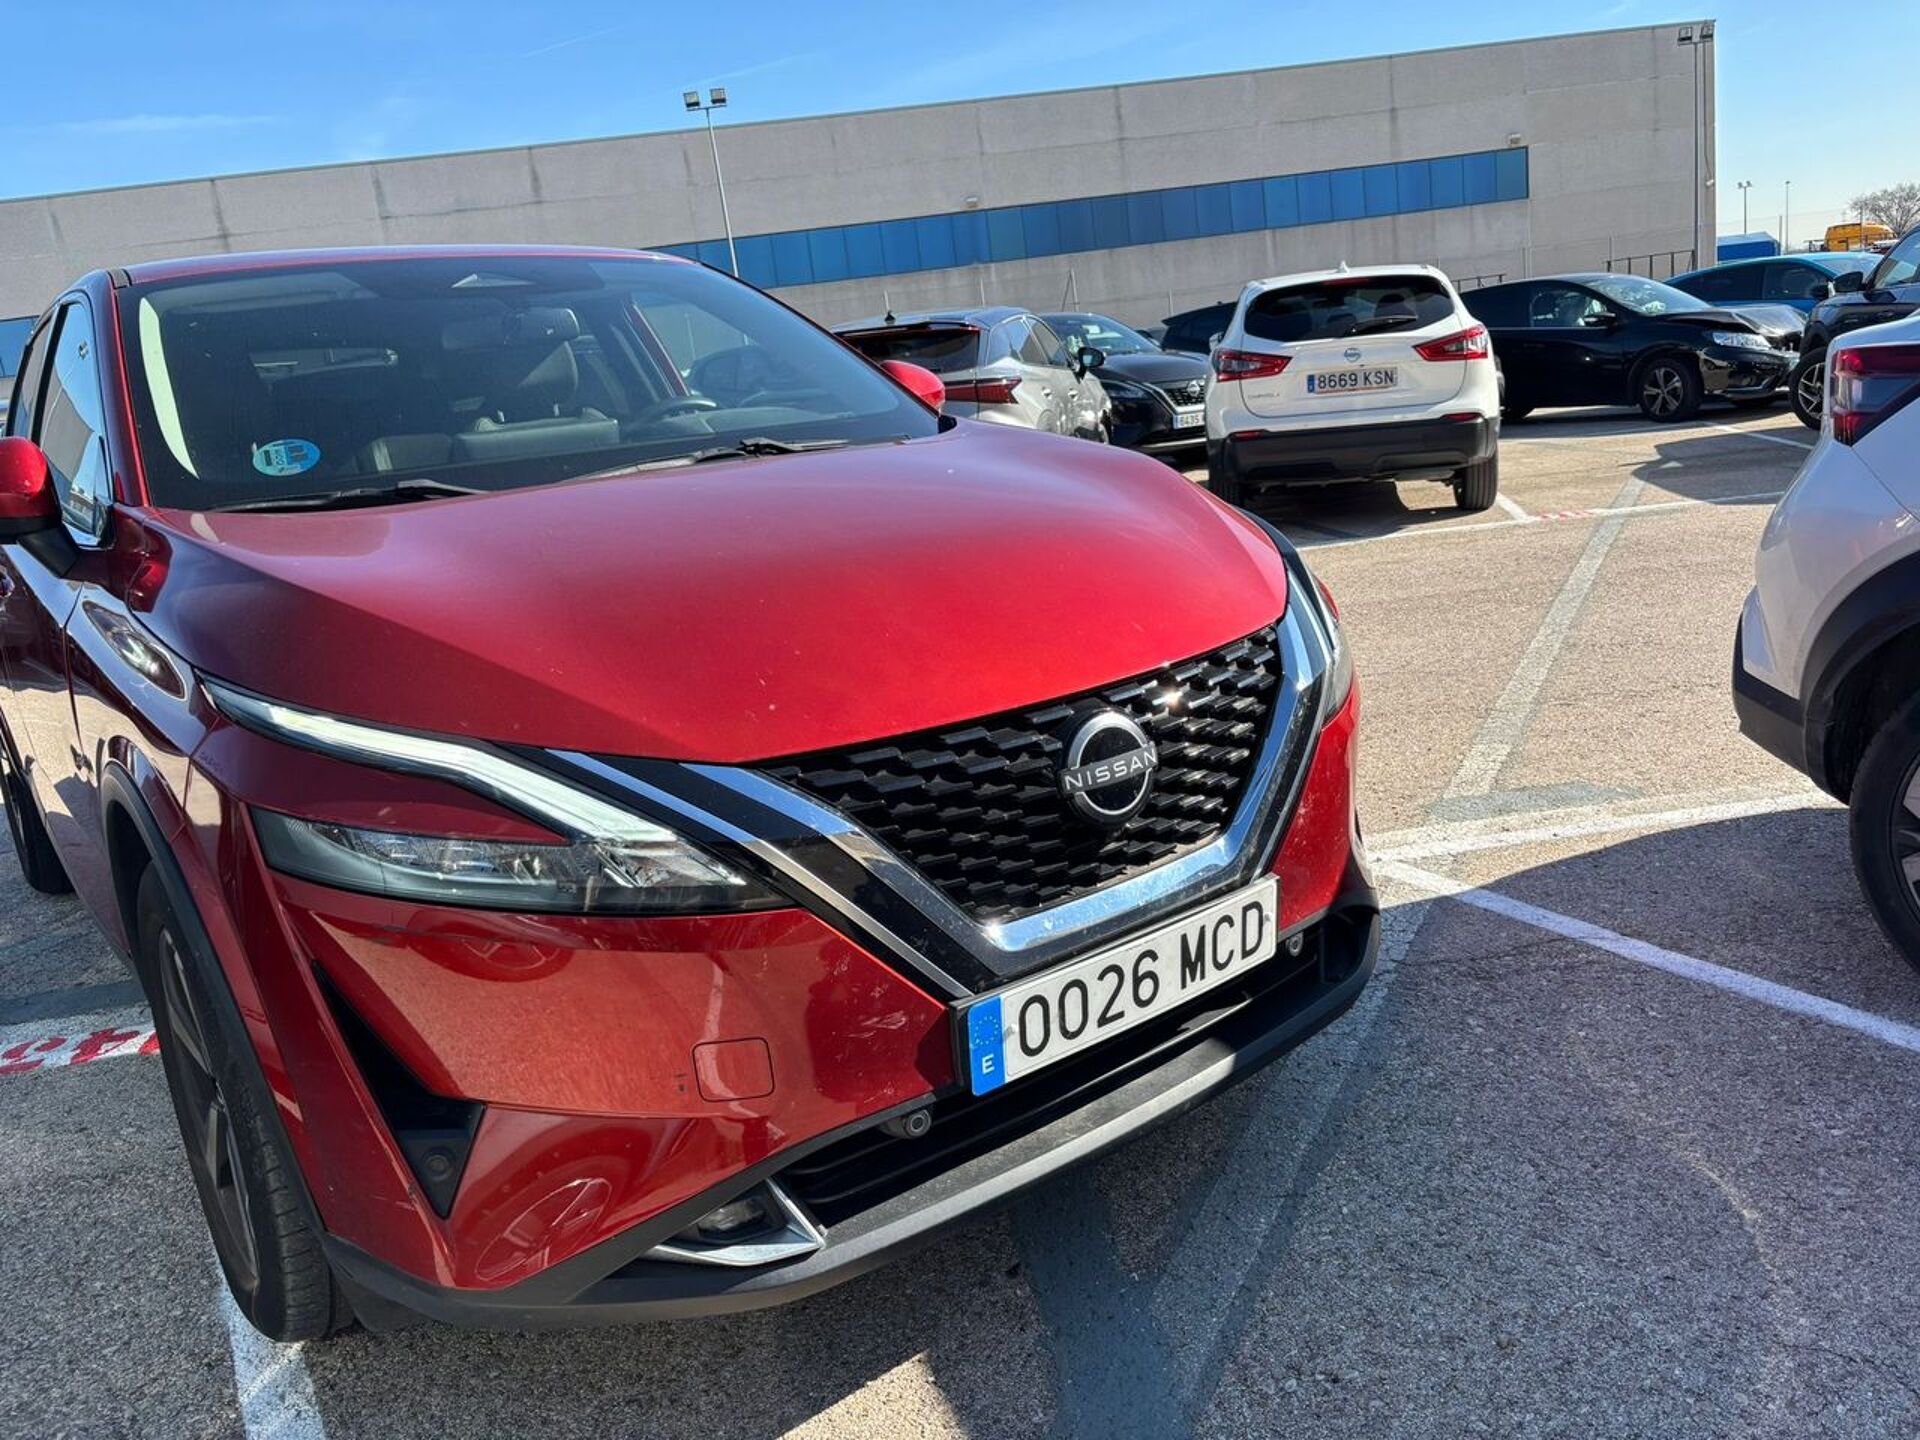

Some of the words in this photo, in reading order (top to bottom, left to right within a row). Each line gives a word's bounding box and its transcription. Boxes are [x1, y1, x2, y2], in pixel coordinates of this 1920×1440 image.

[1318, 372, 1358, 389] 8669
[1363, 370, 1394, 386] KSN
[1064, 748, 1158, 791] NISSAN
[1017, 948, 1160, 1058] 0026
[1179, 899, 1265, 991] MCD
[981, 1053, 996, 1075] E
